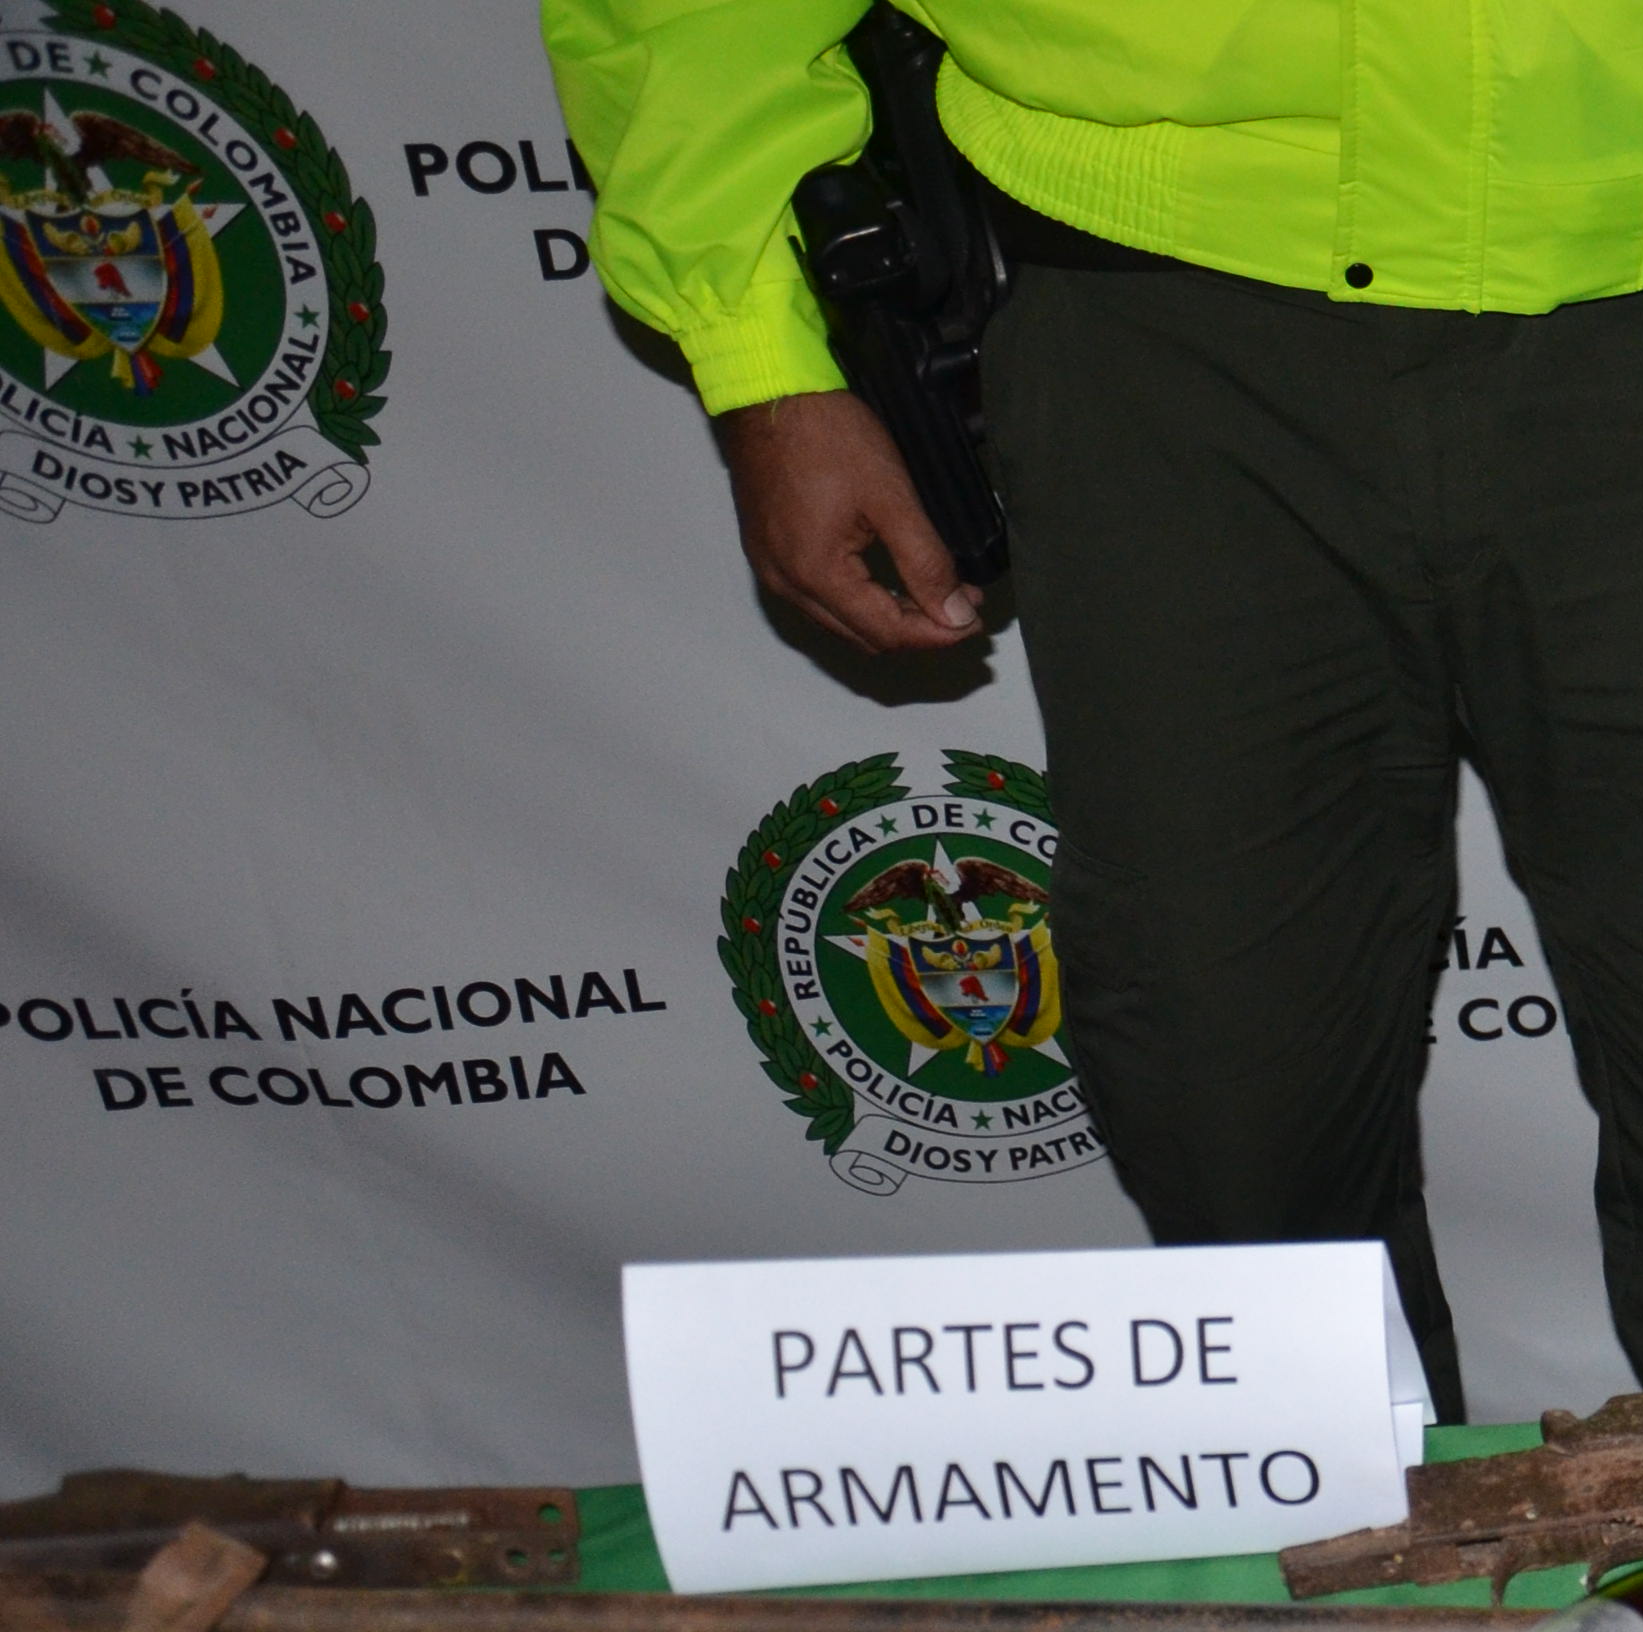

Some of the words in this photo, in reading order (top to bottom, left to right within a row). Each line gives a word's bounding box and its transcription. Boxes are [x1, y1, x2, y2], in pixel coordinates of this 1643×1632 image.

[8, 41, 73, 74] DE
[130, 68, 317, 285] COLOMBIA
[404, 140, 594, 197] POLI
[163, 333, 320, 460] NACIONAL
[177, 449, 308, 508] PATRIA
[913, 803, 964, 829] DE
[0, 988, 263, 1042] OLICÍA
[273, 967, 667, 1041] NACIONAL
[94, 1065, 194, 1112] DE
[208, 1051, 587, 1109] COLOMBIA
[1009, 1125, 1105, 1171] PATRI
[771, 1318, 1096, 1400] PARTES
[1128, 1316, 1239, 1387] DE
[721, 1448, 1322, 1533] ARMAMENTO
